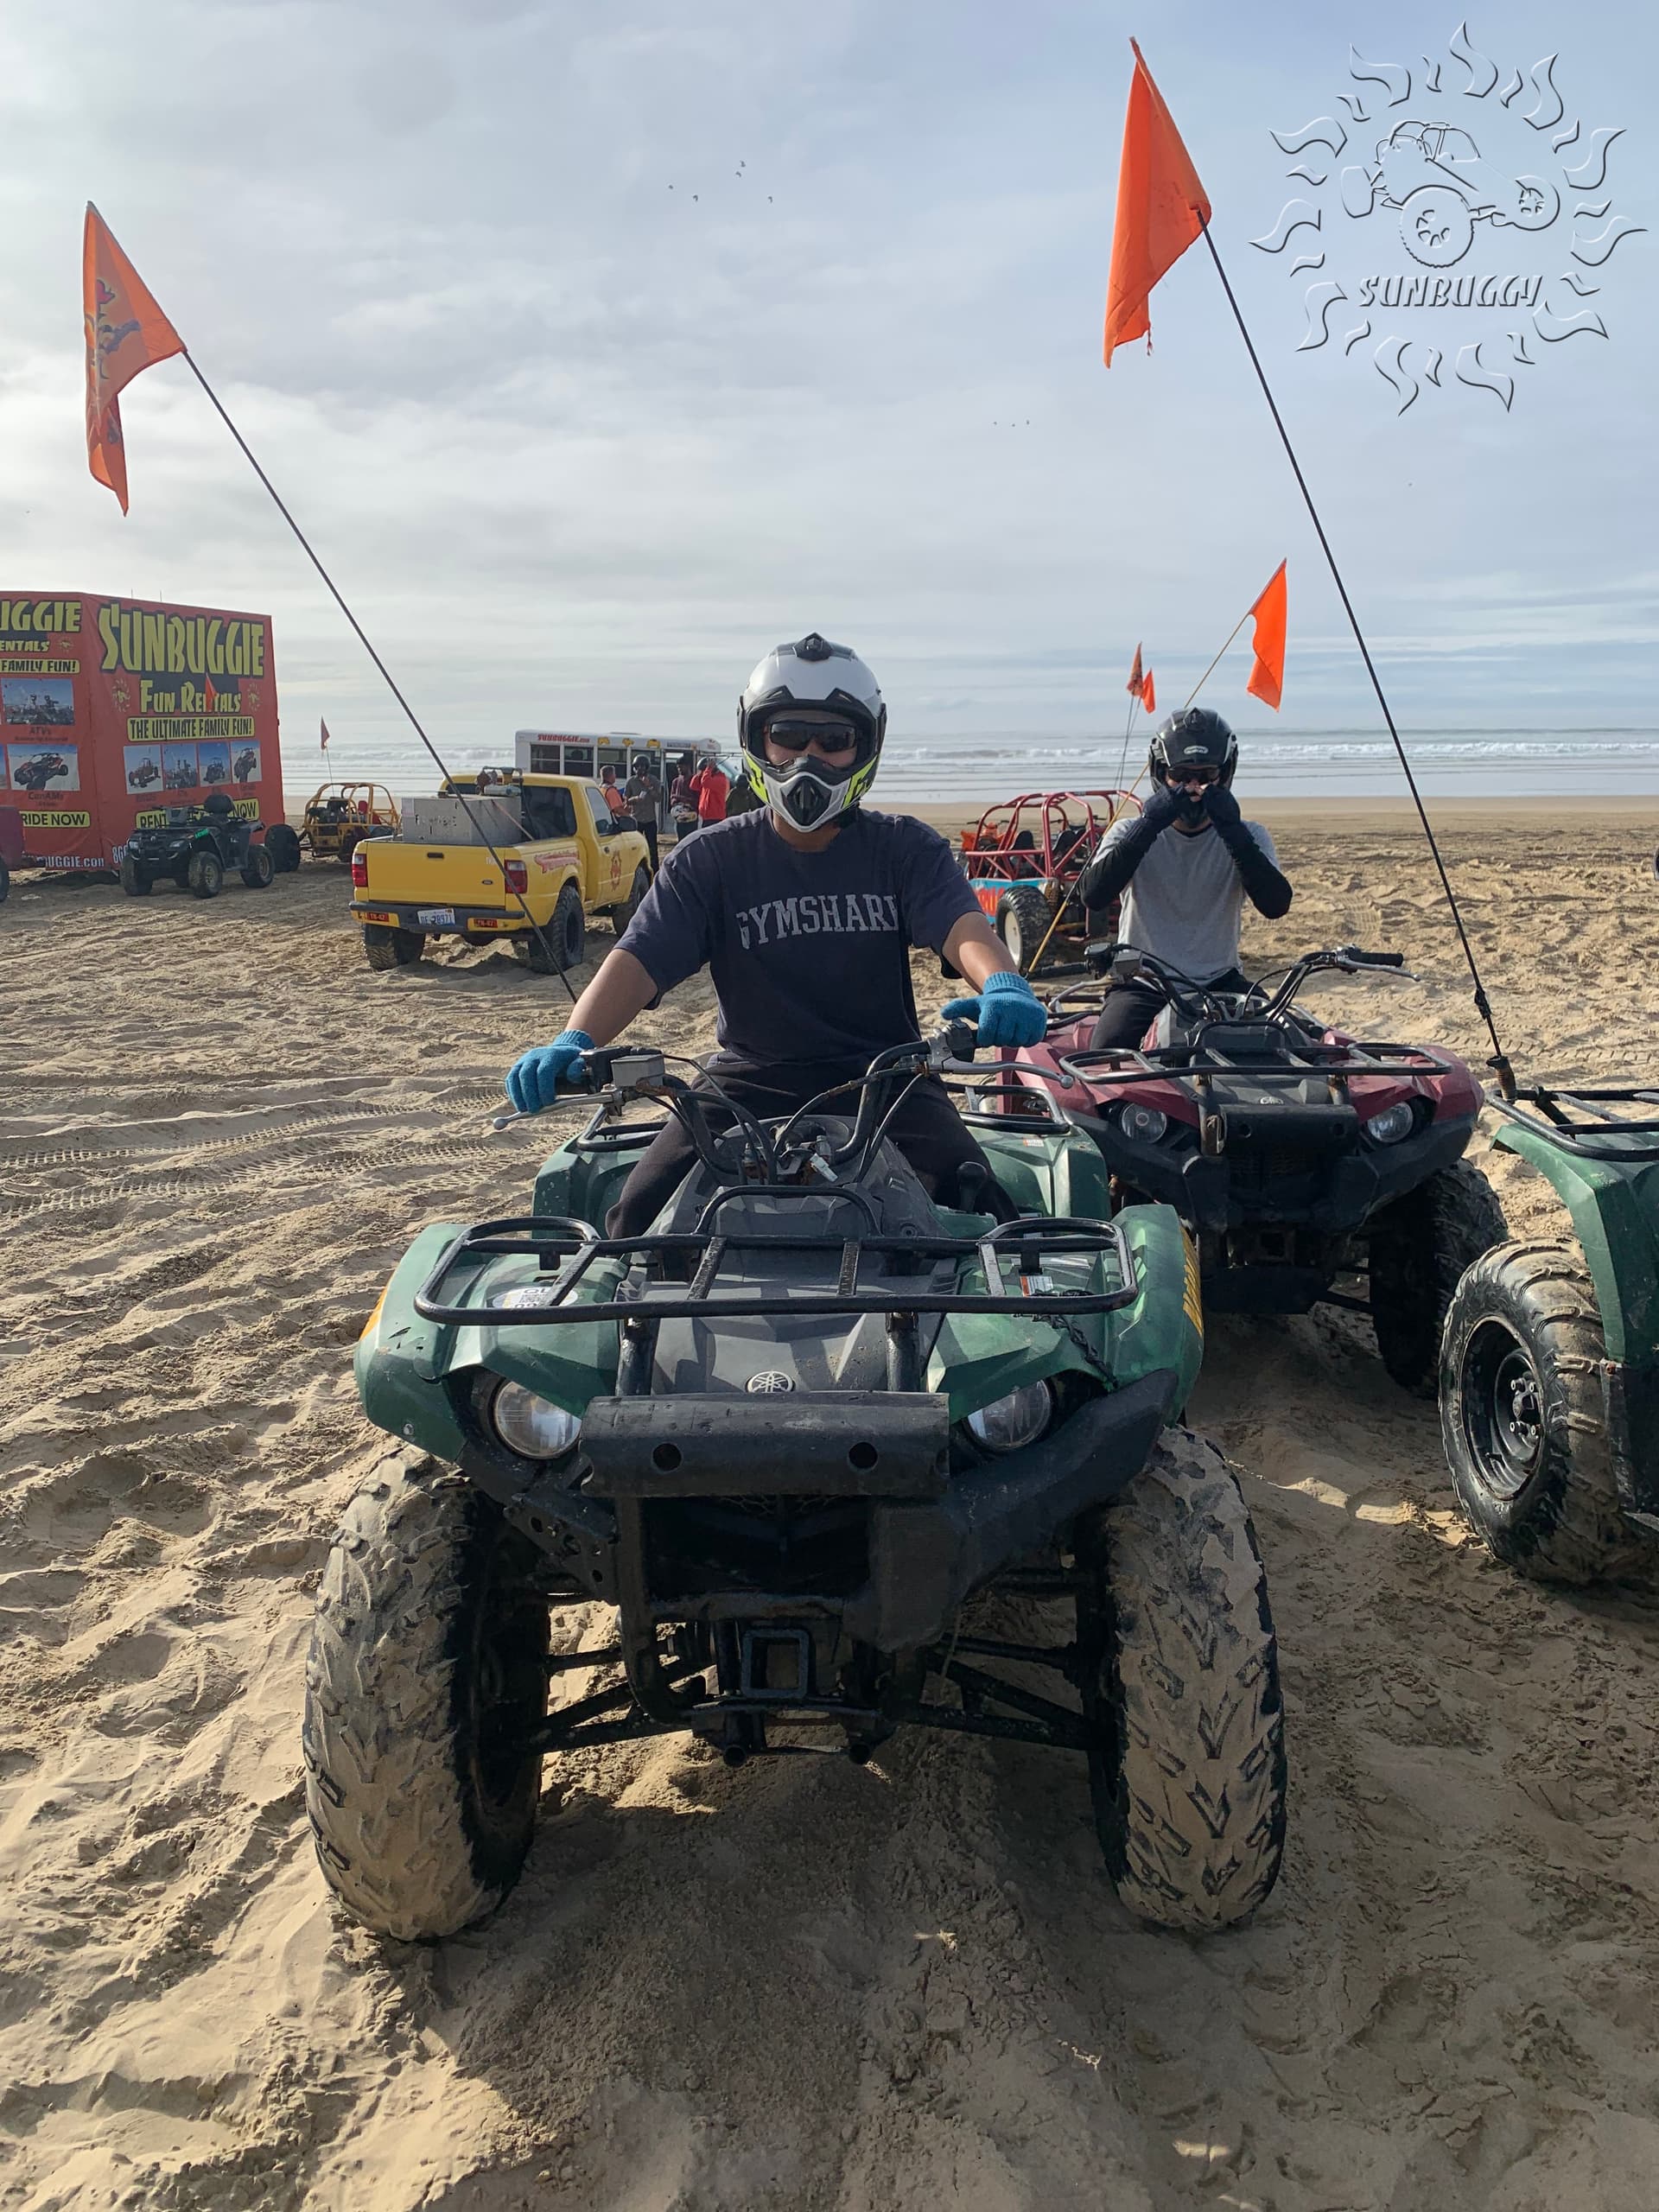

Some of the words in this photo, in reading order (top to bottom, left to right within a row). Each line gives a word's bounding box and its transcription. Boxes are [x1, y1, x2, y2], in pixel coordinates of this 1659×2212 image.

[98, 603, 264, 677] SUNBUGGIE
[1, 659, 42, 671] FAMILY
[48, 659, 76, 671] FUN!
[181, 681, 242, 713] RETALS
[130, 719, 149, 740] THE
[152, 718, 197, 739] ULTIMATE
[199, 717, 230, 736] FAMILY
[232, 717, 252, 735] FUN!
[22, 813, 48, 825] RIDE
[51, 813, 86, 825] NOW
[233, 801, 257, 818] NOW
